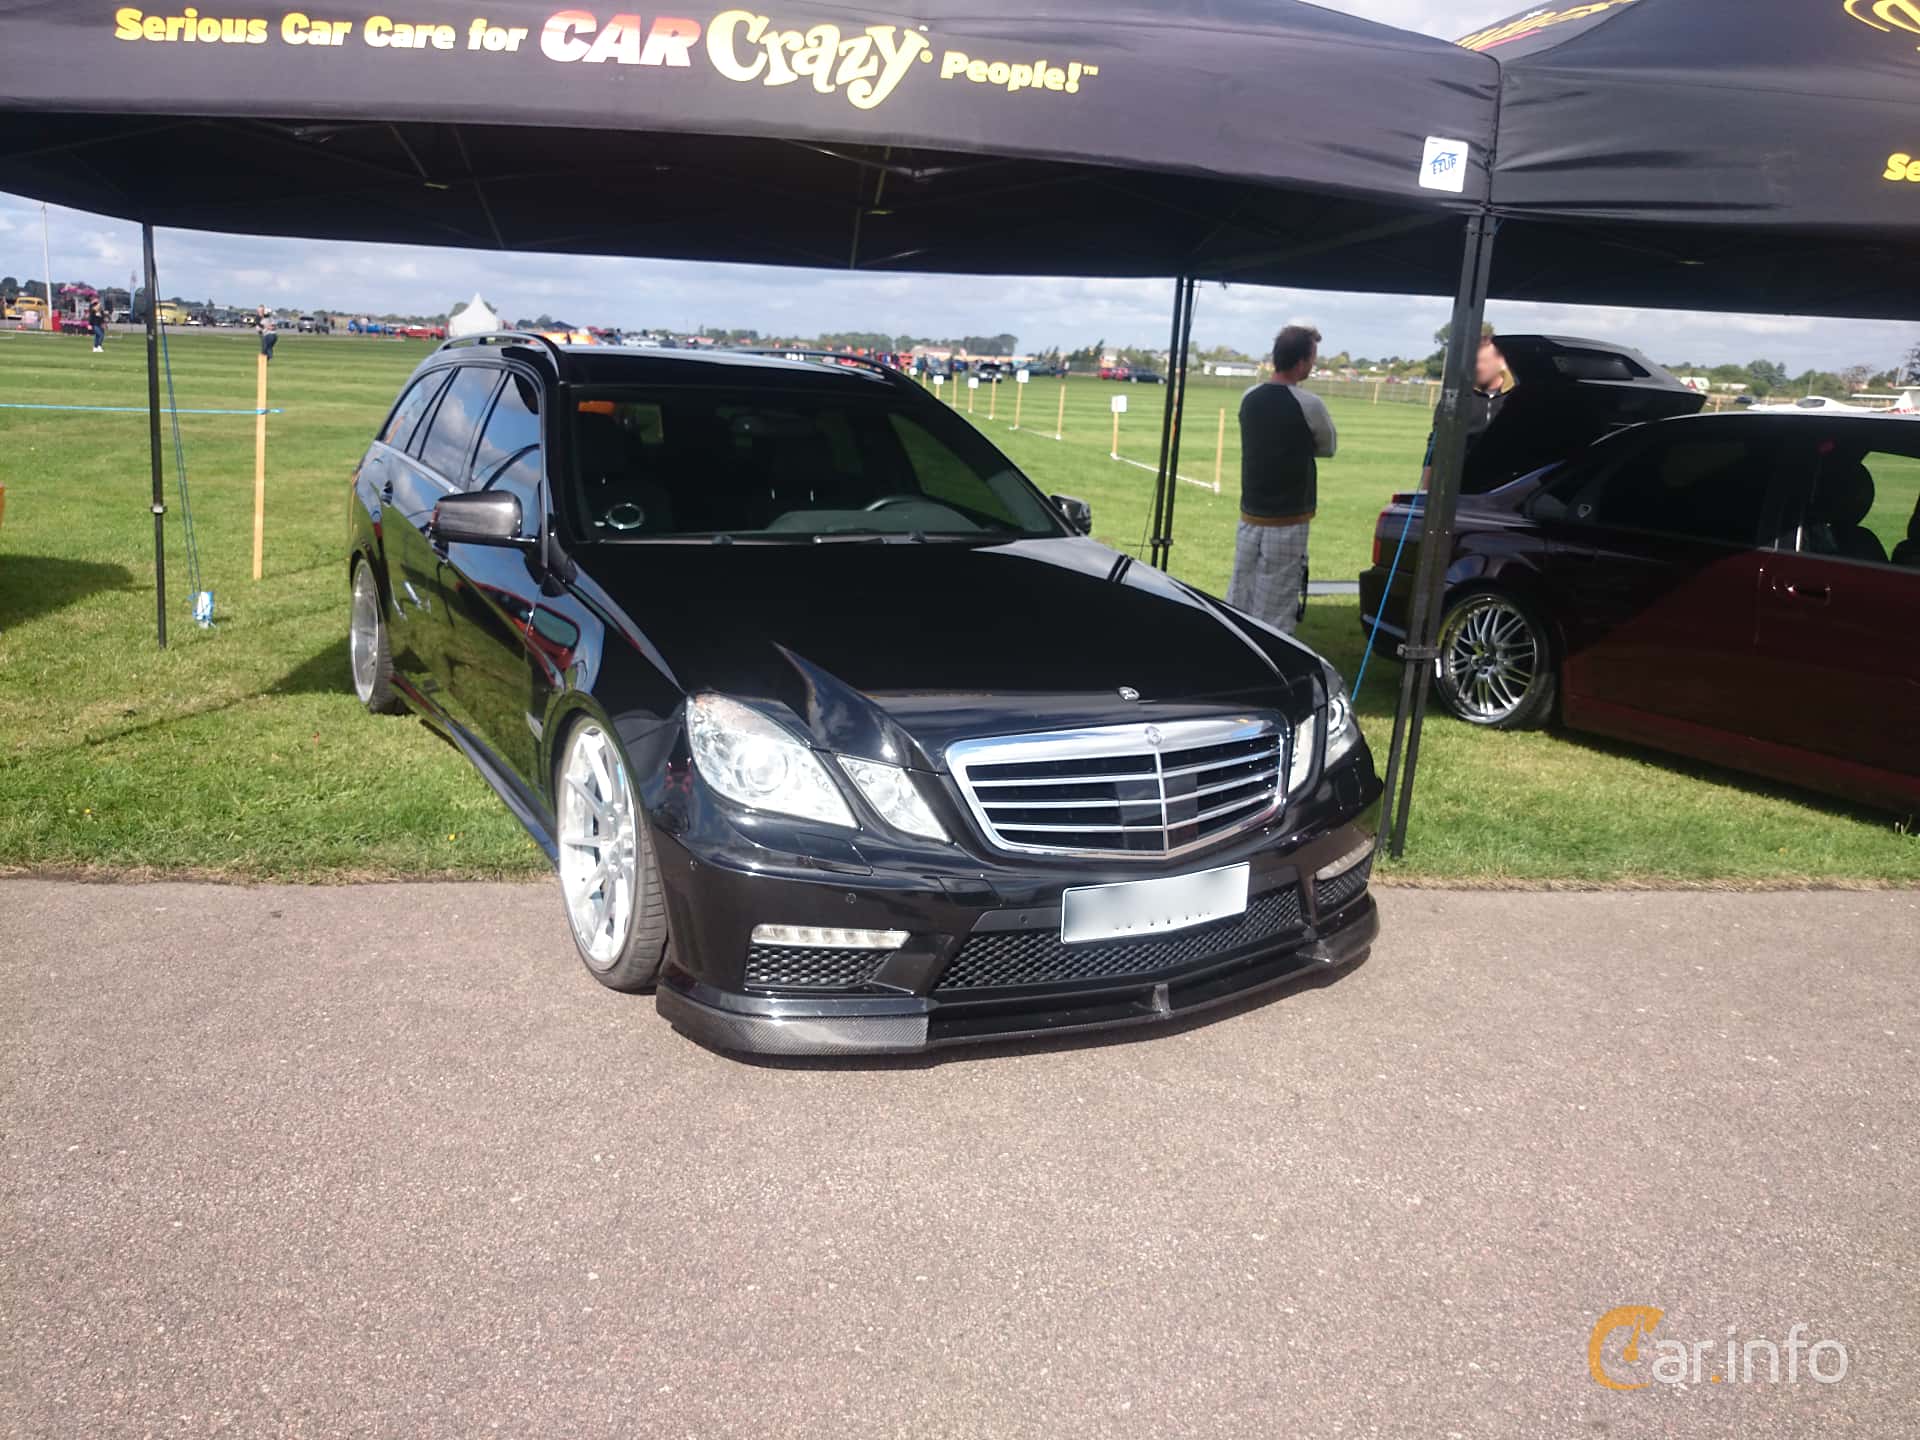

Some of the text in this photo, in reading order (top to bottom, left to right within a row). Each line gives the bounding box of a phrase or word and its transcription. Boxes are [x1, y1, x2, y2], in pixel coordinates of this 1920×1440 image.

[114, 7, 269, 44] Serious
[281, 12, 353, 47] Car
[363, 15, 456, 50] Care
[467, 18, 528, 52] for
[540, 9, 702, 67] CAR
[706, 10, 930, 110] Crazy
